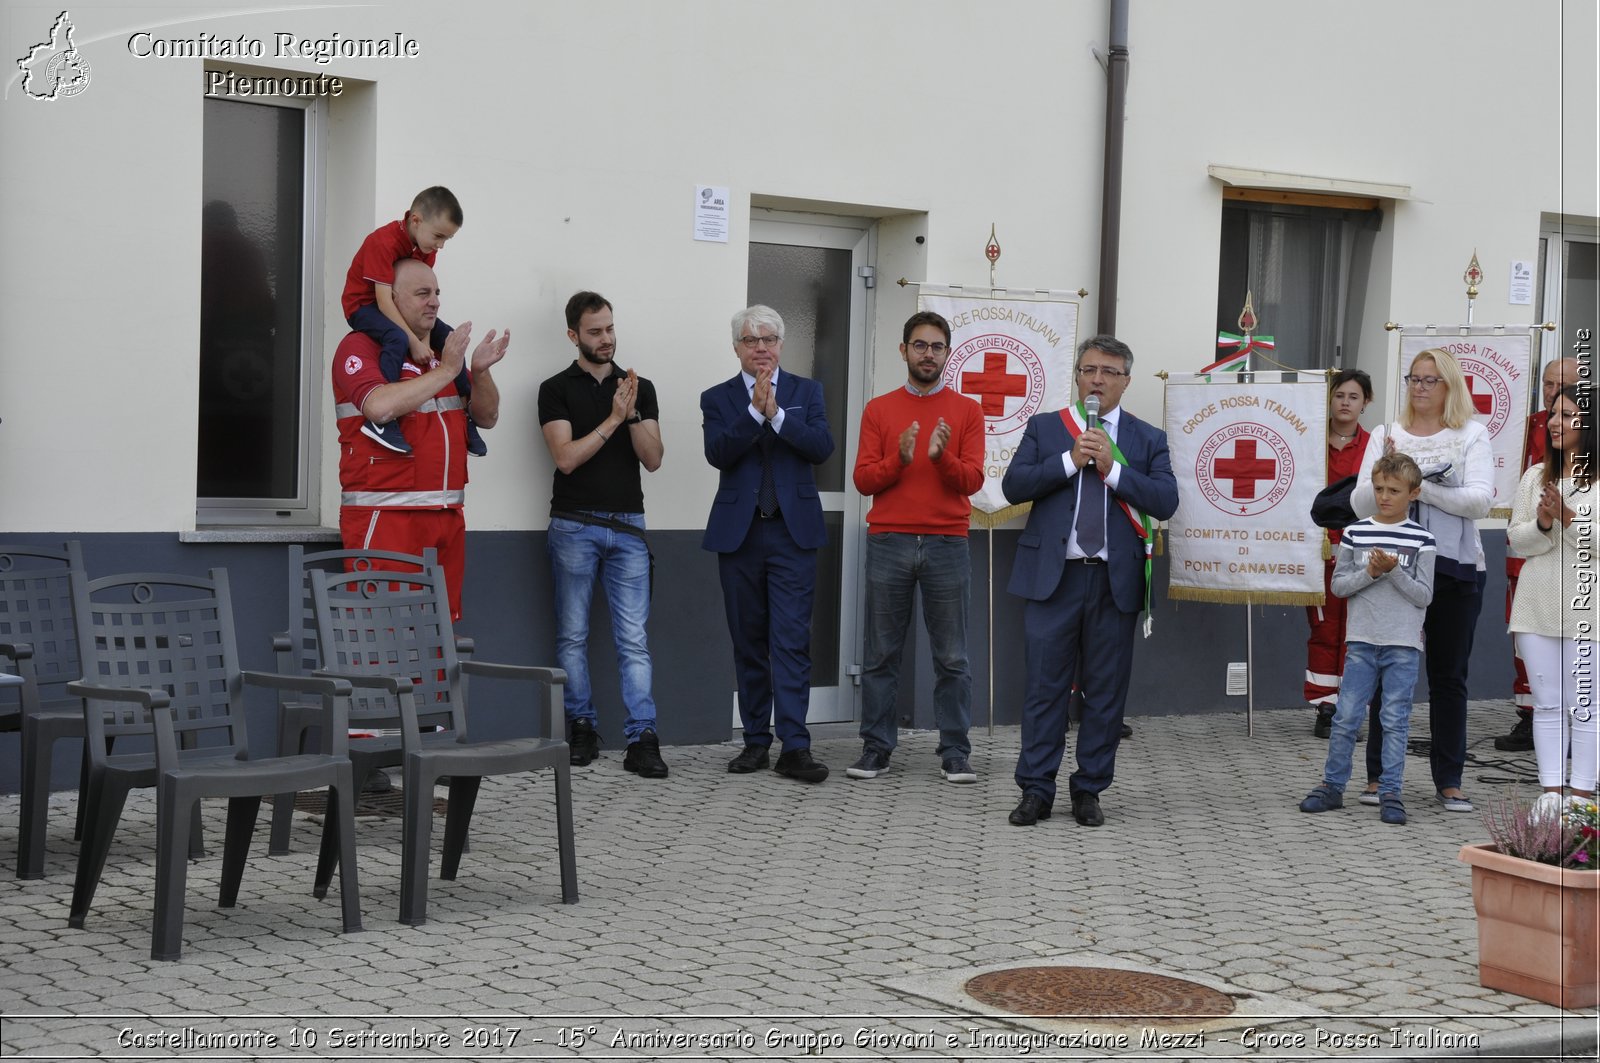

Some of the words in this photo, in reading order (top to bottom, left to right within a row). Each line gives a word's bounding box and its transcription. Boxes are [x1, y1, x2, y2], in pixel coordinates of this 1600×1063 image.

[948, 312, 971, 333] OCE
[971, 307, 1013, 322] ROSSA
[1014, 311, 1061, 348] ITALIANA
[964, 343, 976, 354] DI
[976, 337, 1020, 353] GINEVRA
[1019, 349, 1033, 362] 22
[1460, 361, 1486, 375] EVRA
[1480, 346, 1521, 381] ITALIANA
[1029, 361, 1043, 403] AGOSTO
[1485, 371, 1498, 383] 22
[1494, 382, 1508, 420] AGOSTO
[1016, 404, 1035, 422] 1864
[1182, 403, 1218, 435] CROCE
[1219, 396, 1260, 410] ROSSA
[1263, 399, 1308, 436] ITALIANA
[1227, 425, 1269, 439] GINEVRA
[1487, 421, 1502, 434] 186
[1216, 432, 1227, 442] DI
[1268, 435, 1282, 447] 22
[1198, 439, 1220, 502] CONVENZIONE
[1278, 446, 1292, 485] AGOSTO
[1267, 486, 1285, 503] 1864
[1184, 528, 1249, 540] COMITATO
[1255, 530, 1305, 542] LOCALE
[1238, 546, 1249, 555] DI
[1184, 560, 1221, 573] PONT
[1228, 562, 1306, 575] CANAVESE
